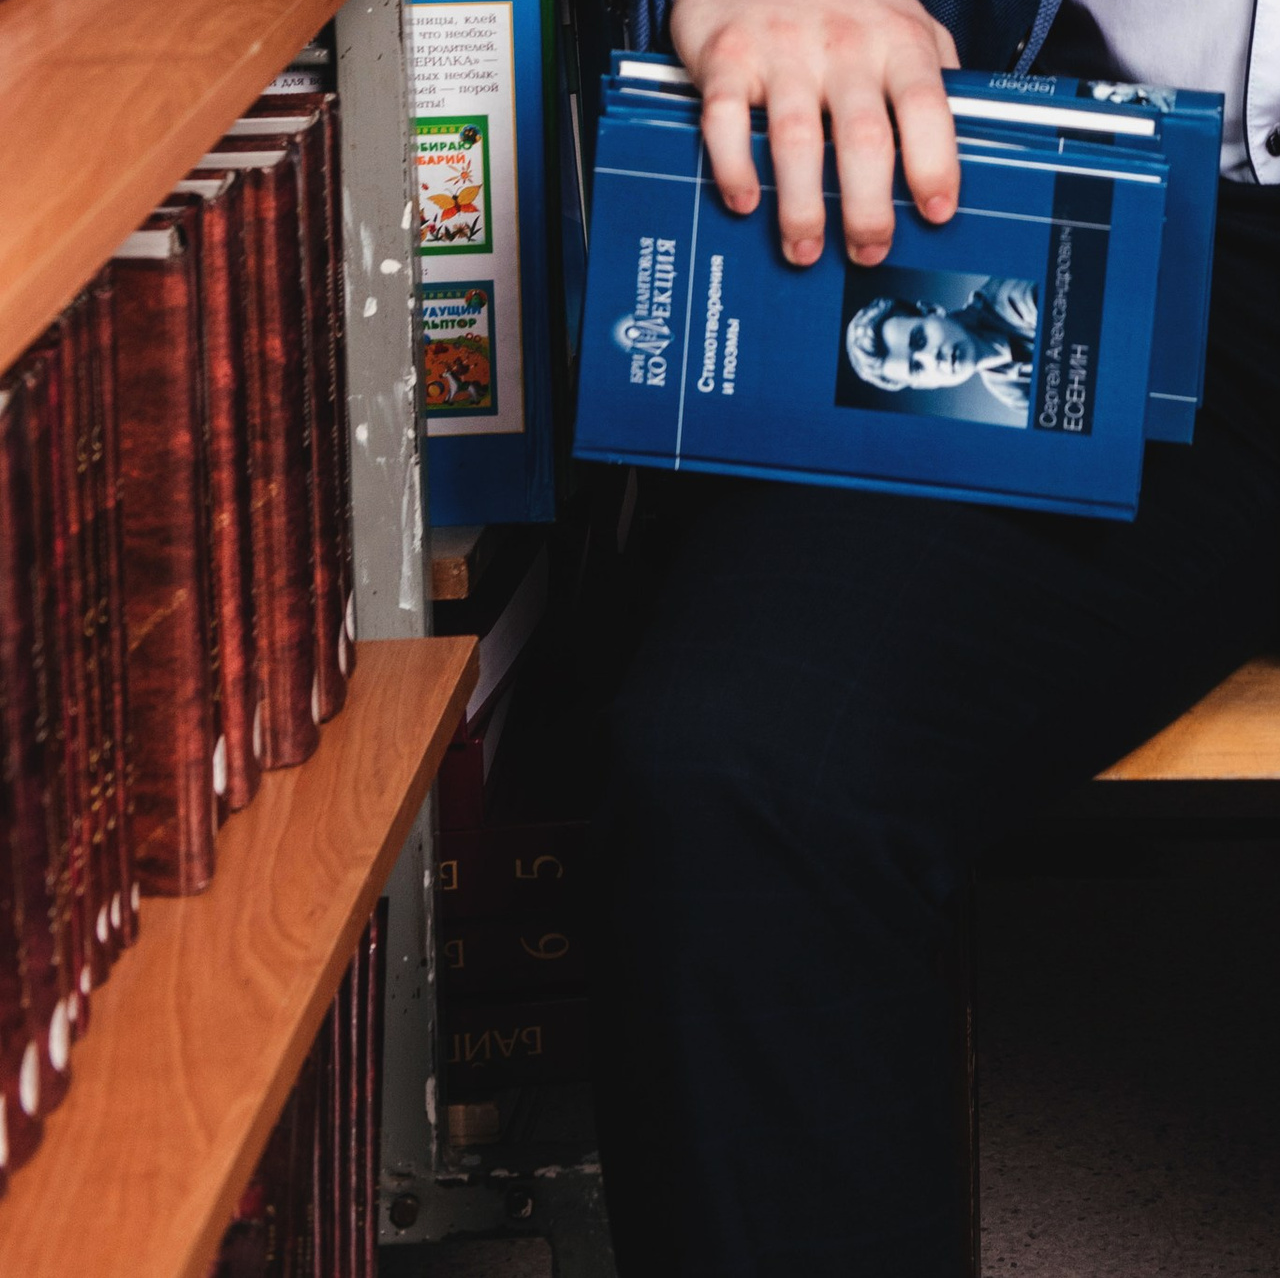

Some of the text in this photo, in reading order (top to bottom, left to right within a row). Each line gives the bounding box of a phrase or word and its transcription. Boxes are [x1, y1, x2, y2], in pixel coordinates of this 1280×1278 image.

[464, 13, 497, 25] клей
[418, 28, 498, 39] что необхо-
[428, 42, 498, 57] родителей.
[444, 69, 498, 81] необык-
[458, 83, 499, 96] порой
[696, 254, 724, 394] Стихотворения
[722, 318, 740, 395] и поэмы
[1039, 363, 1062, 428] Сергей
[1063, 344, 1089, 432] ЕСЕНИН
